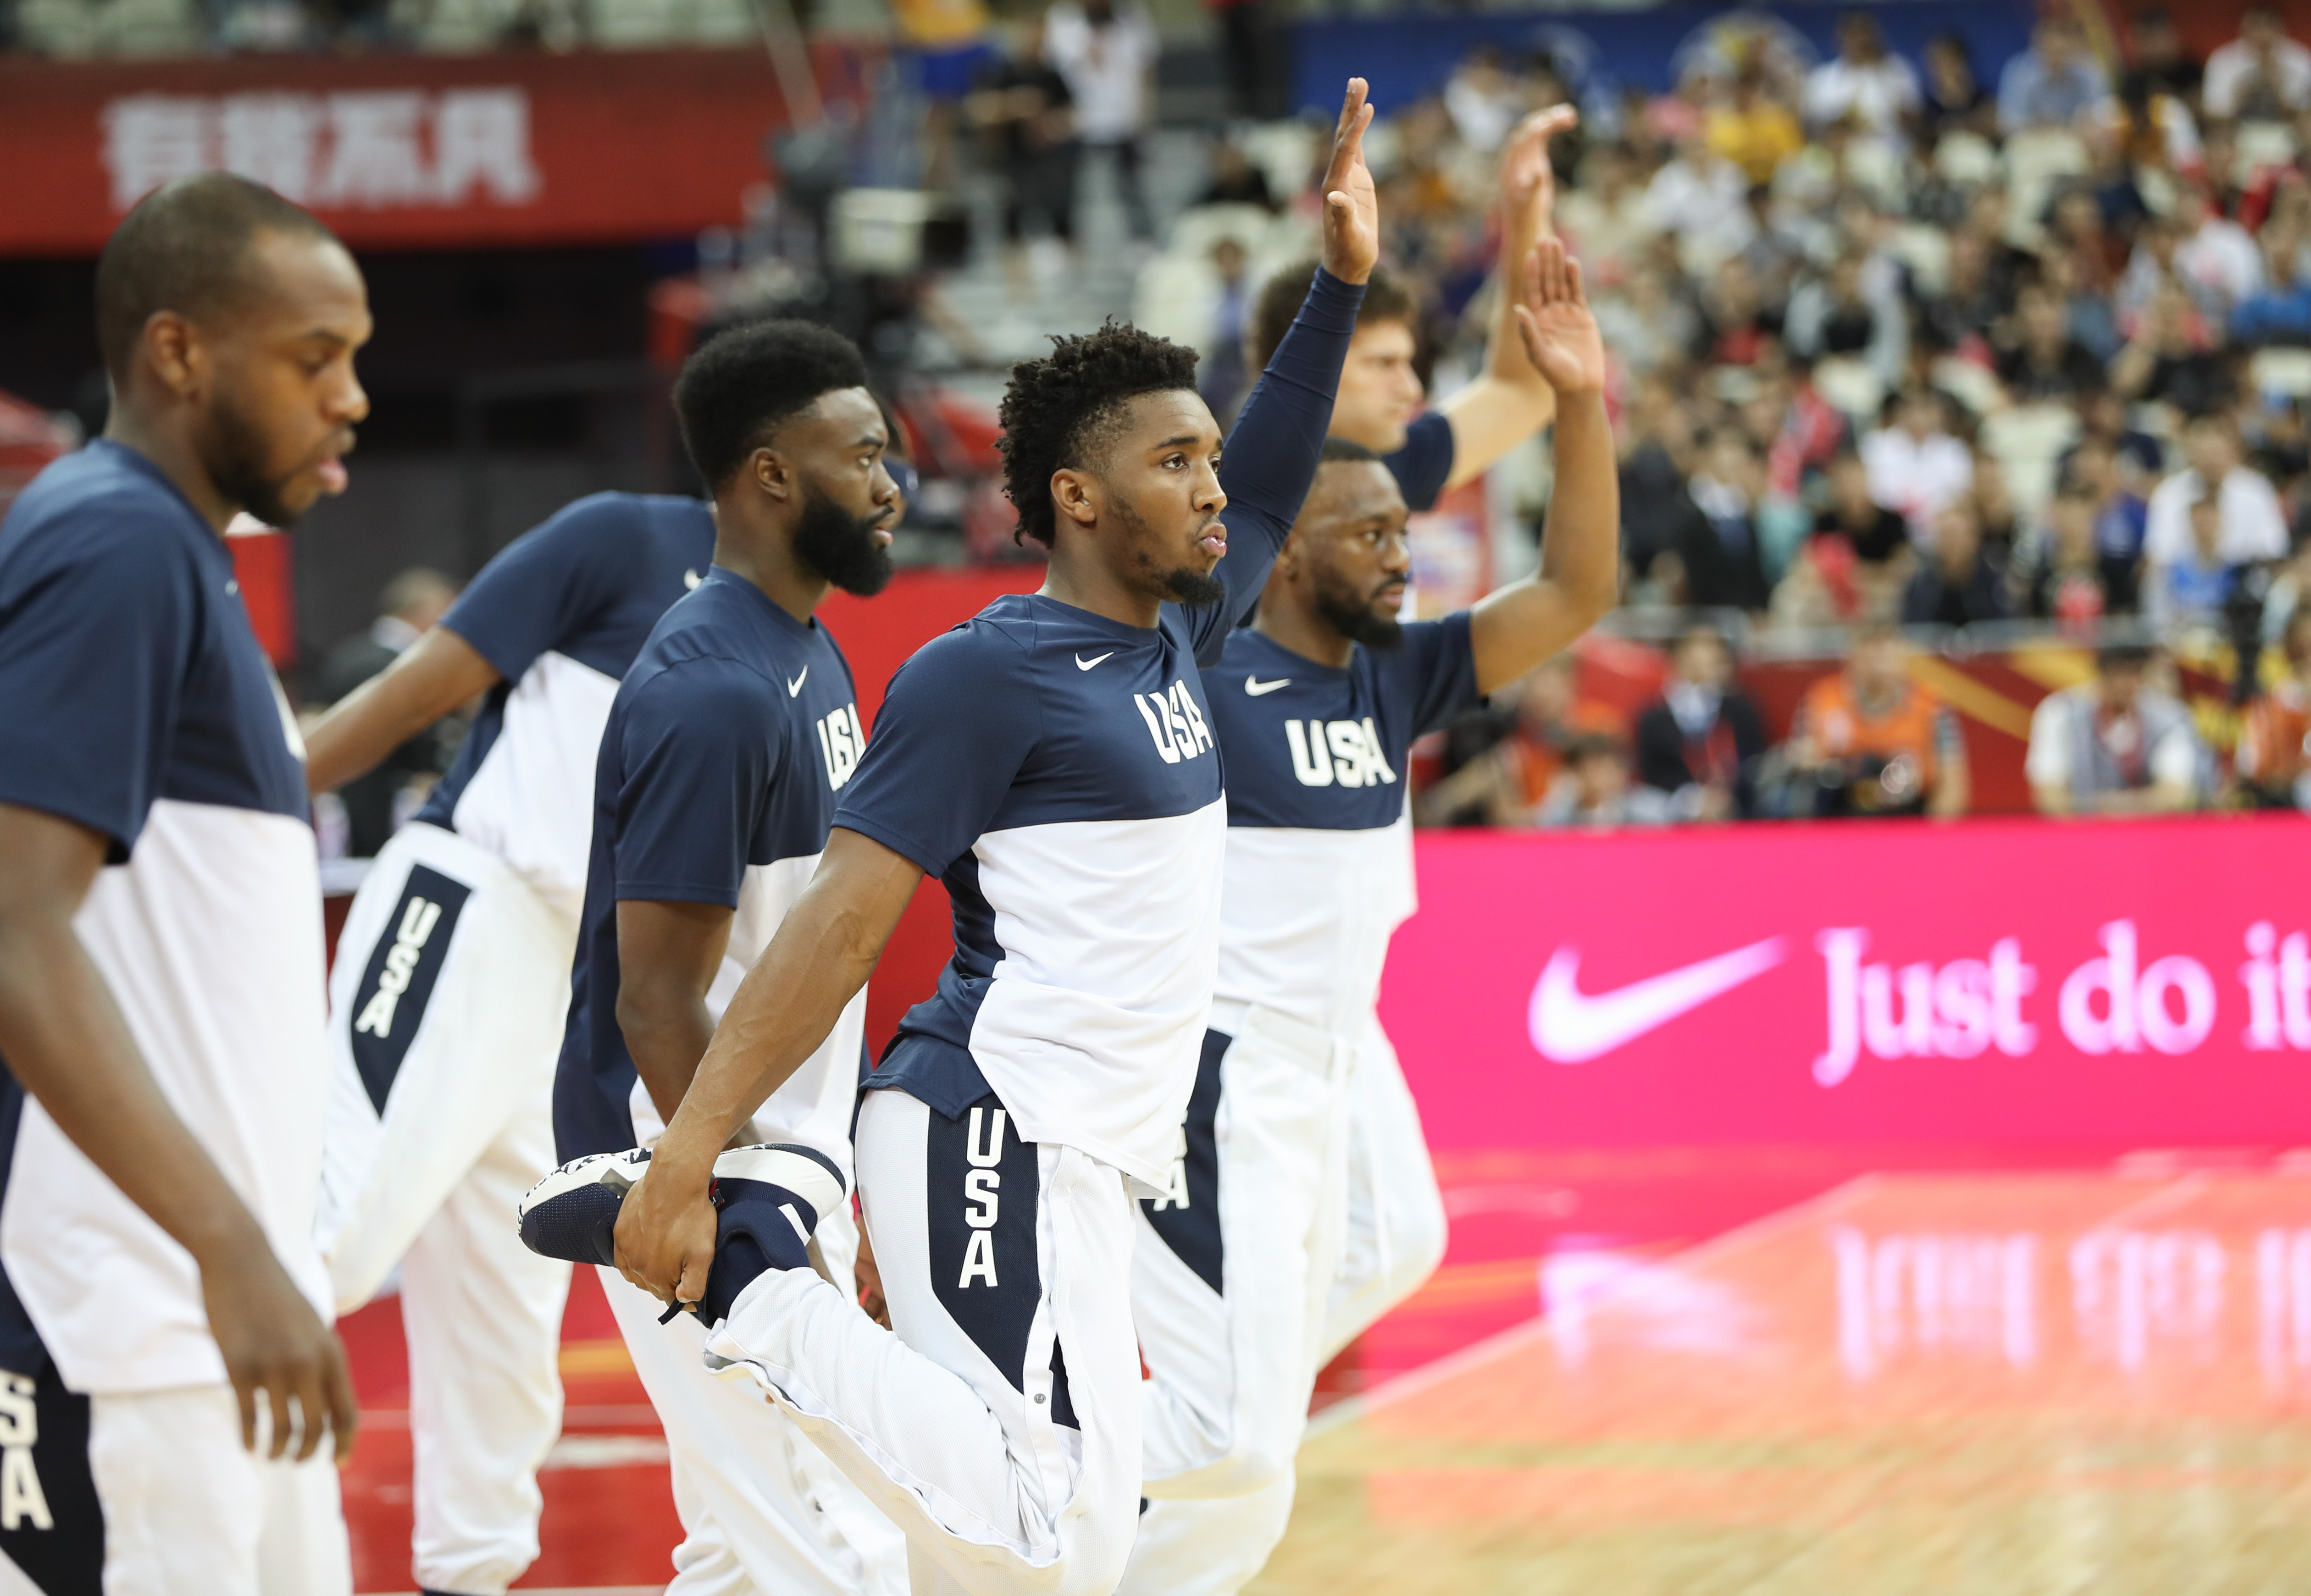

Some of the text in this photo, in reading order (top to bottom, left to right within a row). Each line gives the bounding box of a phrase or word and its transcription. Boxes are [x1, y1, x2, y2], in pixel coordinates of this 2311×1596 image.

[816, 702, 867, 792] USA
[1133, 679, 1214, 764] USA
[1286, 717, 1397, 788] USA
[355, 896, 442, 1038] USA
[1812, 918, 2311, 1087] Just do it
[958, 1107, 1006, 1288] USA
